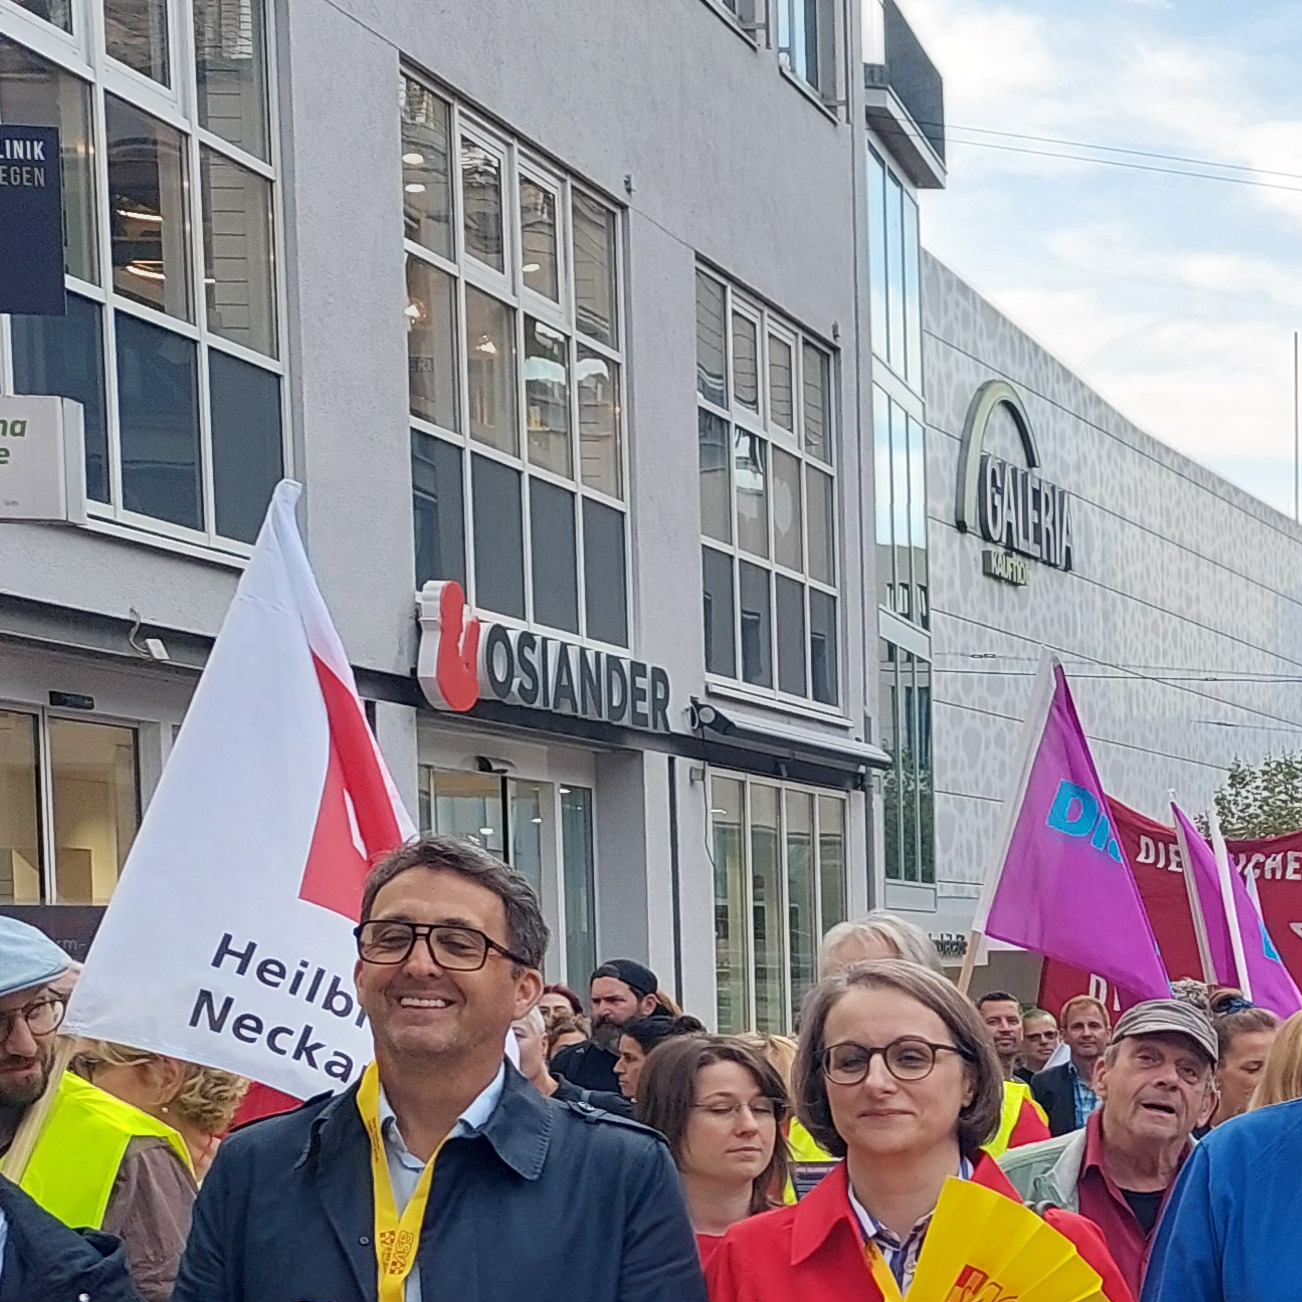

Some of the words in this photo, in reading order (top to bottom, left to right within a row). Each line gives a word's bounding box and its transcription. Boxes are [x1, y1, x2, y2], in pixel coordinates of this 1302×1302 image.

[984, 455, 1075, 571] GALERIA
[486, 623, 671, 732] OSIANDER
[189, 988, 356, 1084] Necka
